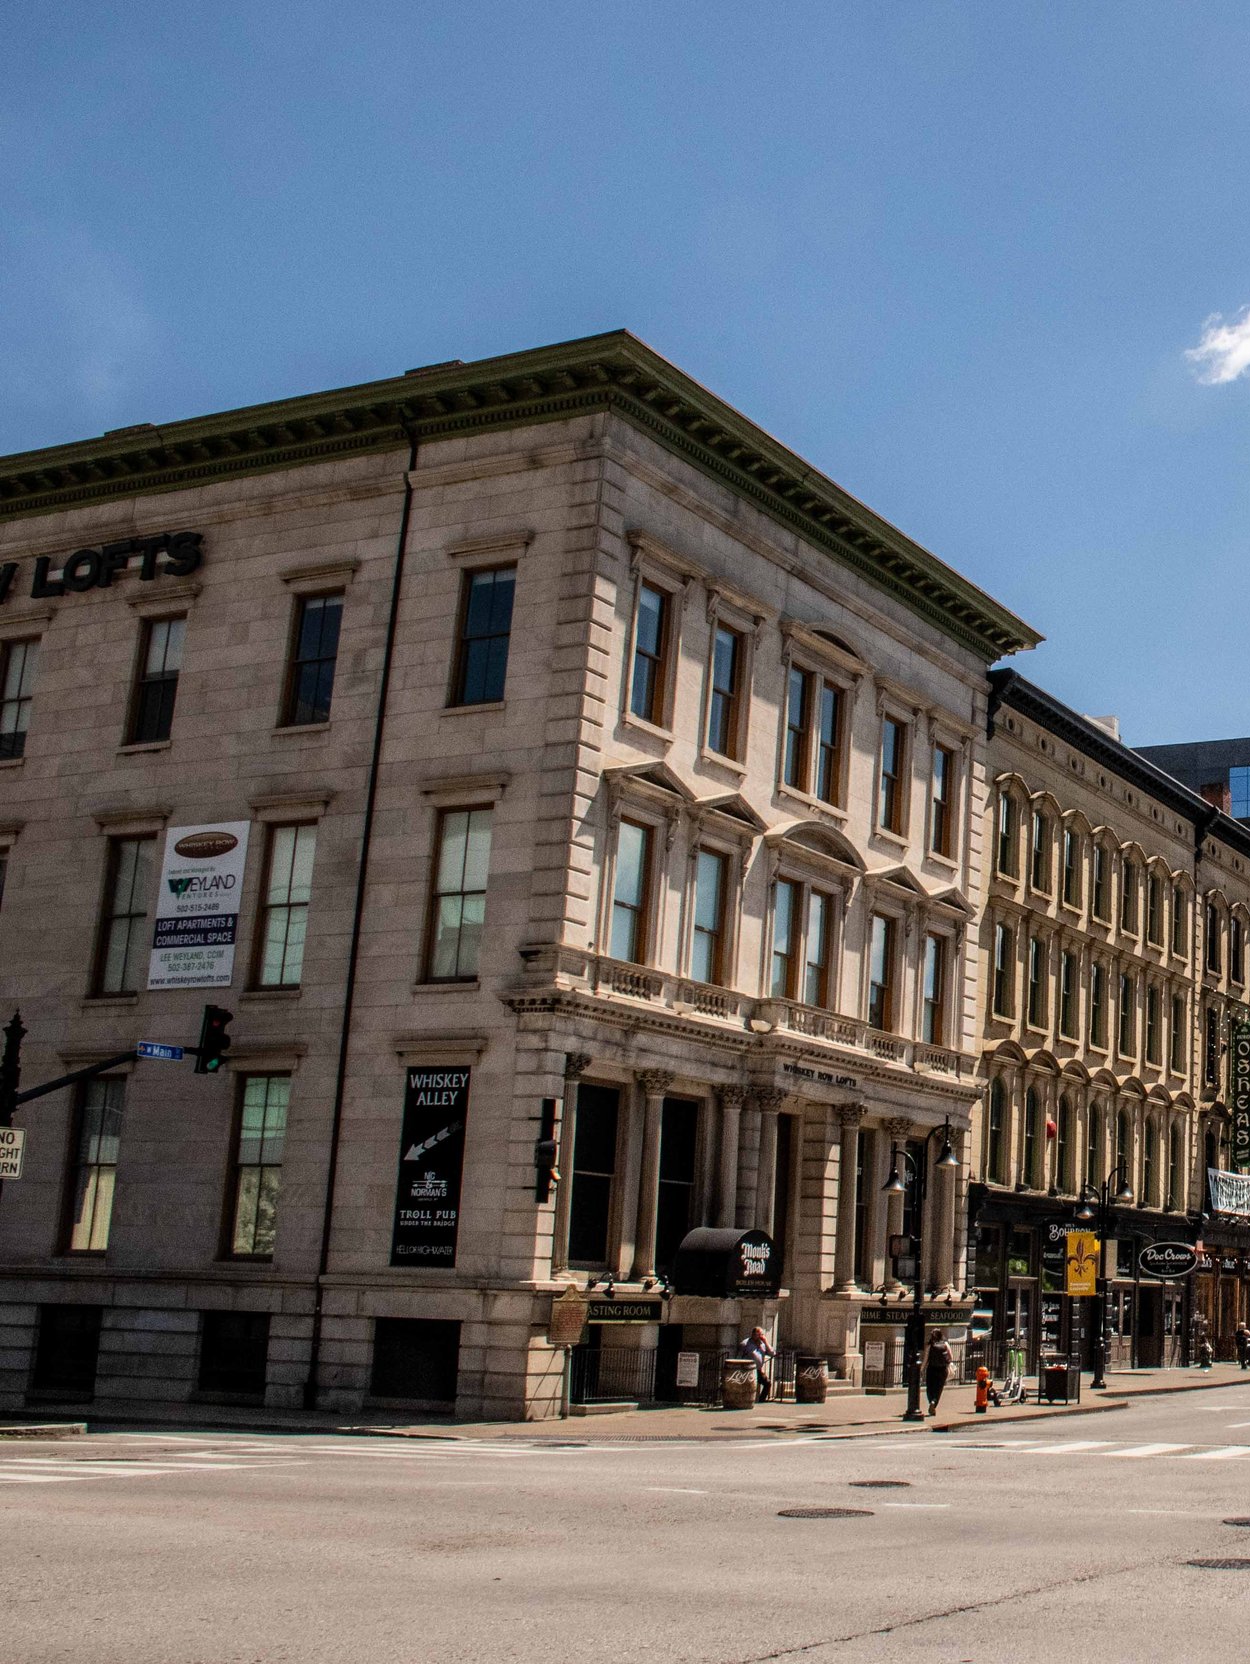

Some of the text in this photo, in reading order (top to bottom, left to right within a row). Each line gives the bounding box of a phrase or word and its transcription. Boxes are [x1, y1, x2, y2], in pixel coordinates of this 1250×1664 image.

[31, 532, 204, 598] LOFTS
[158, 917, 234, 932] LOFT APARTMENTS &
[156, 932, 232, 946] COMMERCIAL SPACE
[153, 1045, 172, 1058] Main
[410, 1073, 469, 1088] WHISKEY
[783, 1063, 857, 1087] WHISKEY ROW LOFTS
[416, 1091, 459, 1106] ALLEY
[0, 1132, 15, 1145] NO
[0, 1147, 20, 1159] GHT
[0, 1162, 18, 1173] RN
[411, 1188, 447, 1196] NORMAN'S
[399, 1210, 457, 1219] TROLL PUB
[741, 1243, 771, 1260] Monk's
[1147, 1249, 1164, 1260] Doc
[744, 1259, 766, 1277] Road
[588, 1305, 651, 1316] ASTING ROOM
[861, 1311, 881, 1320] RIME
[930, 1311, 964, 1320] SEAFOOD
